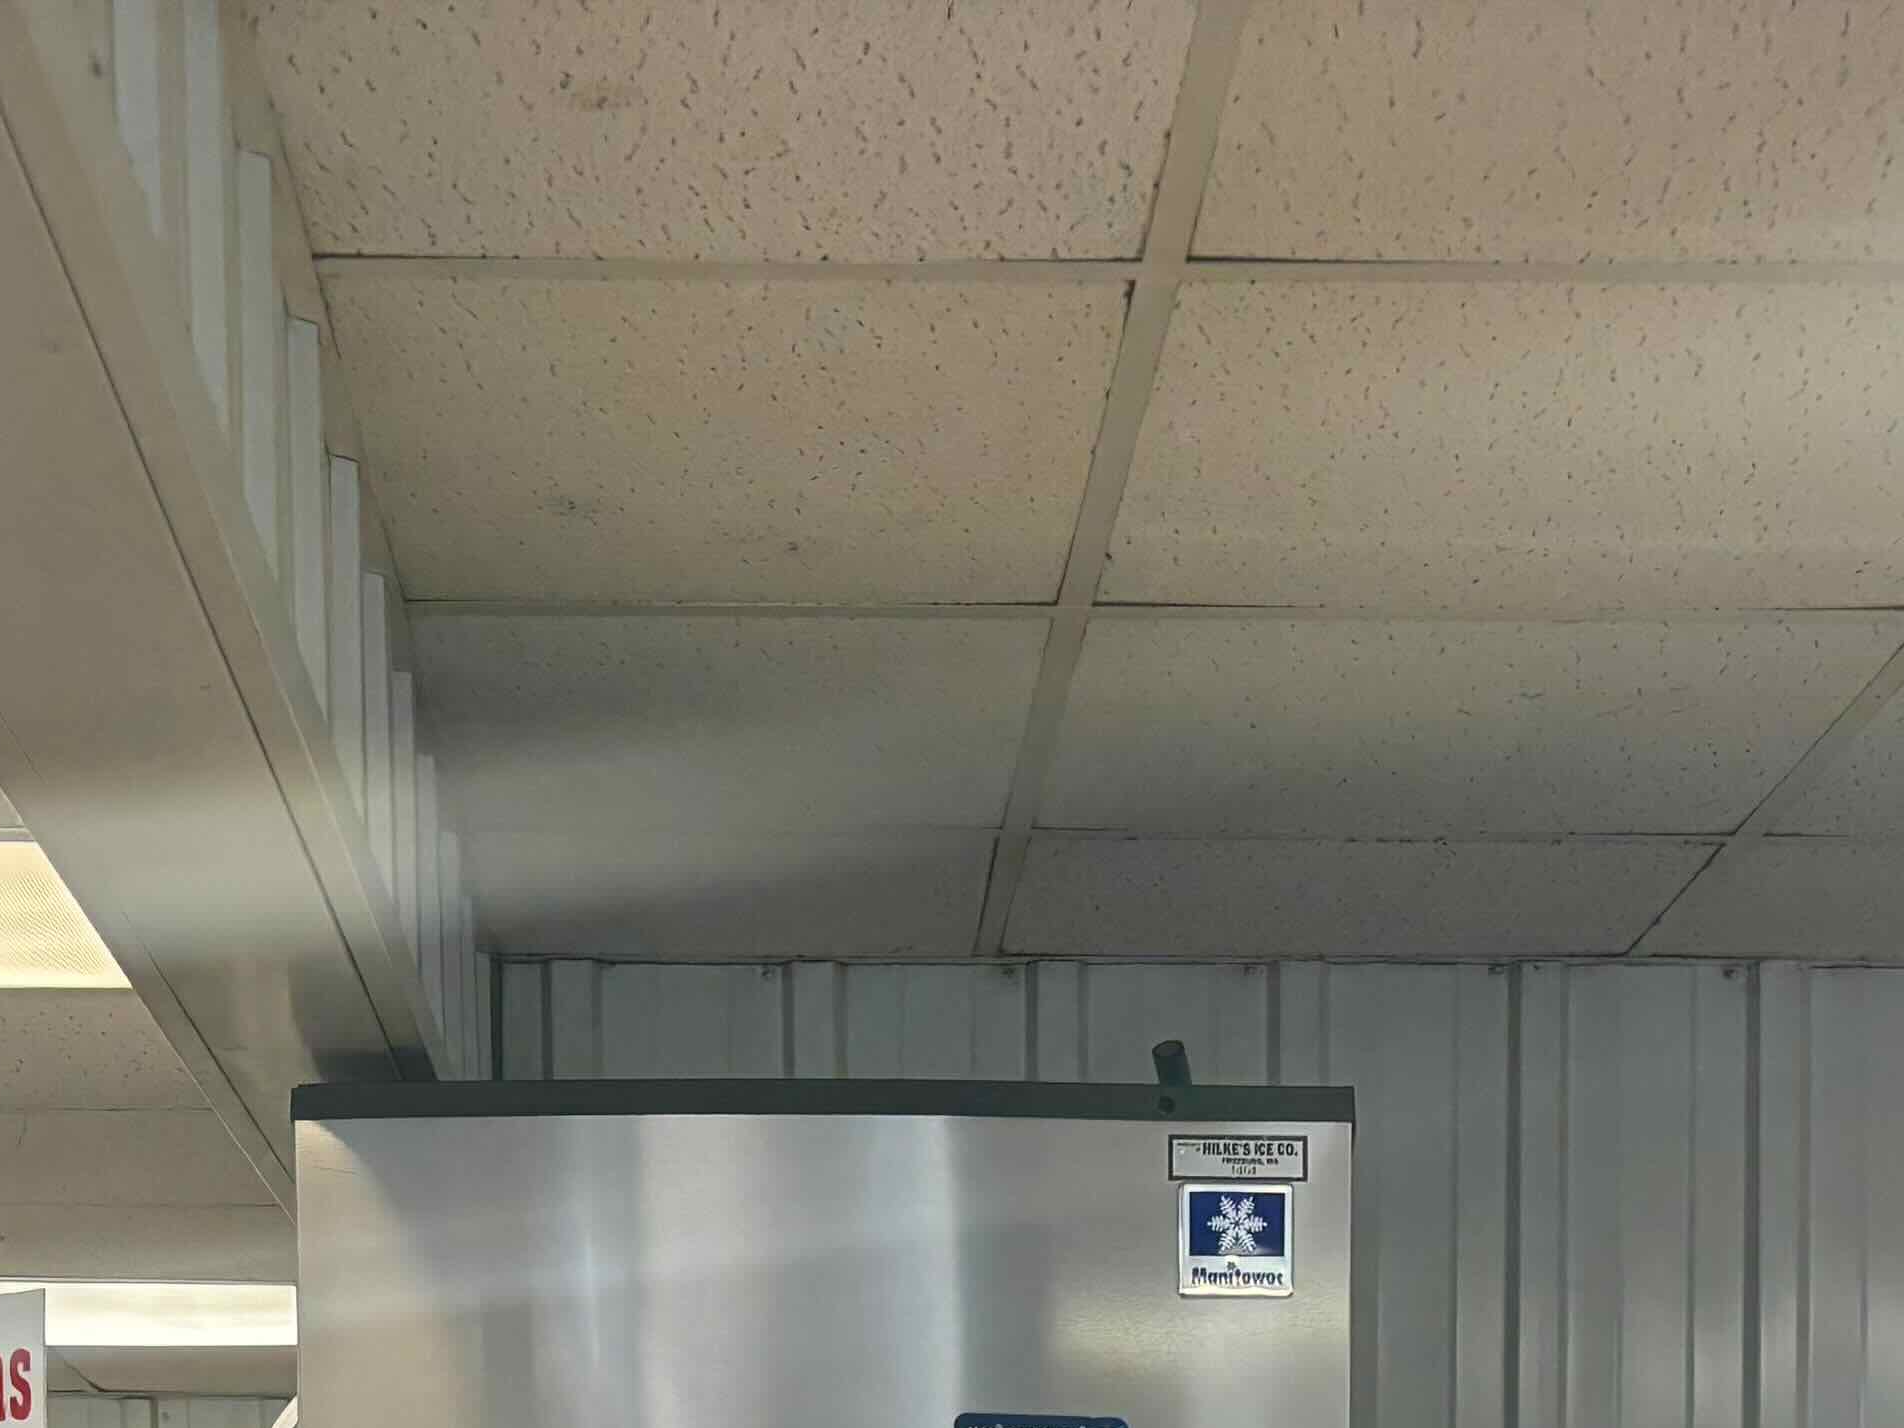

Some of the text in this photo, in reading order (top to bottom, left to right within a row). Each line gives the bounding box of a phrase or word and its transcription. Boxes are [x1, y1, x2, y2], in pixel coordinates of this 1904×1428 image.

[1202, 1142, 1251, 1156] HILKE'S
[1254, 1143, 1274, 1156] ICE
[1276, 1143, 1298, 1156] CO.
[1191, 1267, 1283, 1285] Manitowoc
